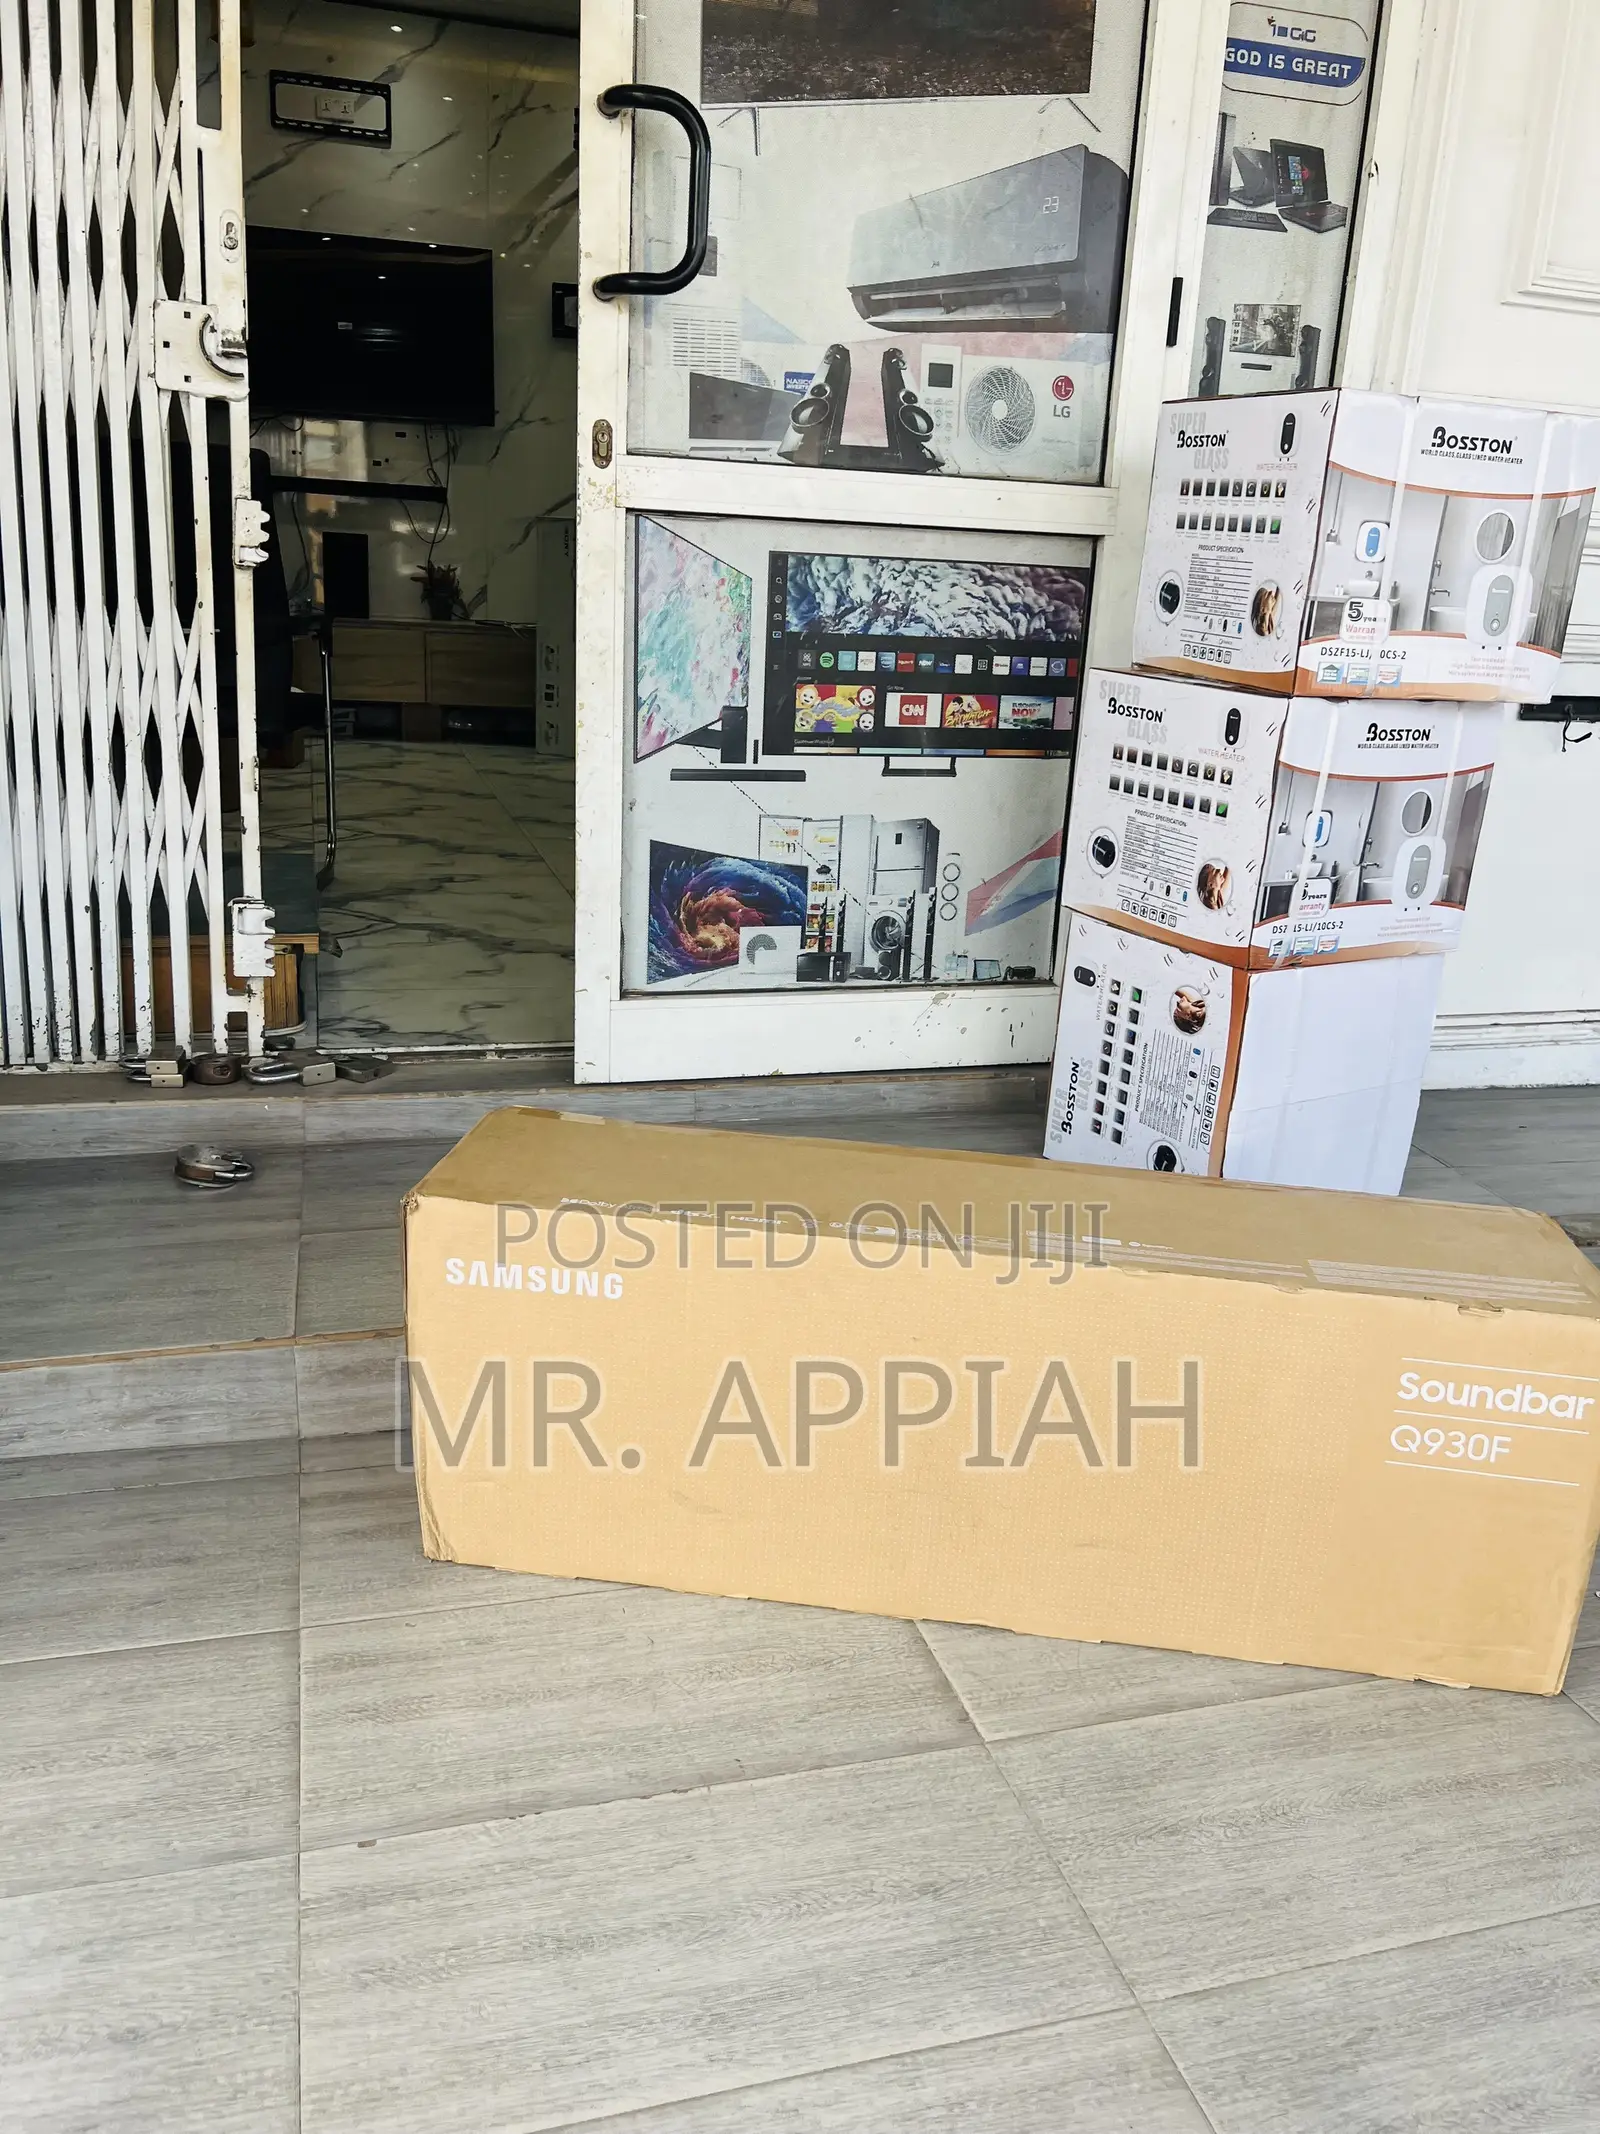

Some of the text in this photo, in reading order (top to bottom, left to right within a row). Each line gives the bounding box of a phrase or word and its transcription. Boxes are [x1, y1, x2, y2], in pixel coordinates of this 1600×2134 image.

[1225, 47, 1351, 79] GOD IS GREAT
[1043, 196, 1060, 213] 23
[1053, 404, 1071, 418] LG
[1170, 412, 1206, 434] SUPER
[1177, 429, 1227, 448] BOSSTON
[1431, 426, 1513, 455] BOSSTON
[1193, 448, 1229, 469] GLASS
[1347, 601, 1363, 622] 5
[1099, 679, 1141, 705] SUPER
[901, 704, 924, 717] CNN
[1107, 697, 1163, 723] BOSSTON
[1127, 719, 1168, 745] GLASS
[1366, 722, 1431, 742] BOSSTON
[1299, 903, 1325, 911] arranty
[1076, 1056, 1093, 1111] GLASS
[1061, 1061, 1080, 1135] BOSSTON
[1051, 1087, 1068, 1144] SUPER
[445, 1256, 624, 1299] SAMSUNG
[1397, 1372, 1595, 1420] Soundbar
[1390, 1424, 1513, 1463] Q930F
